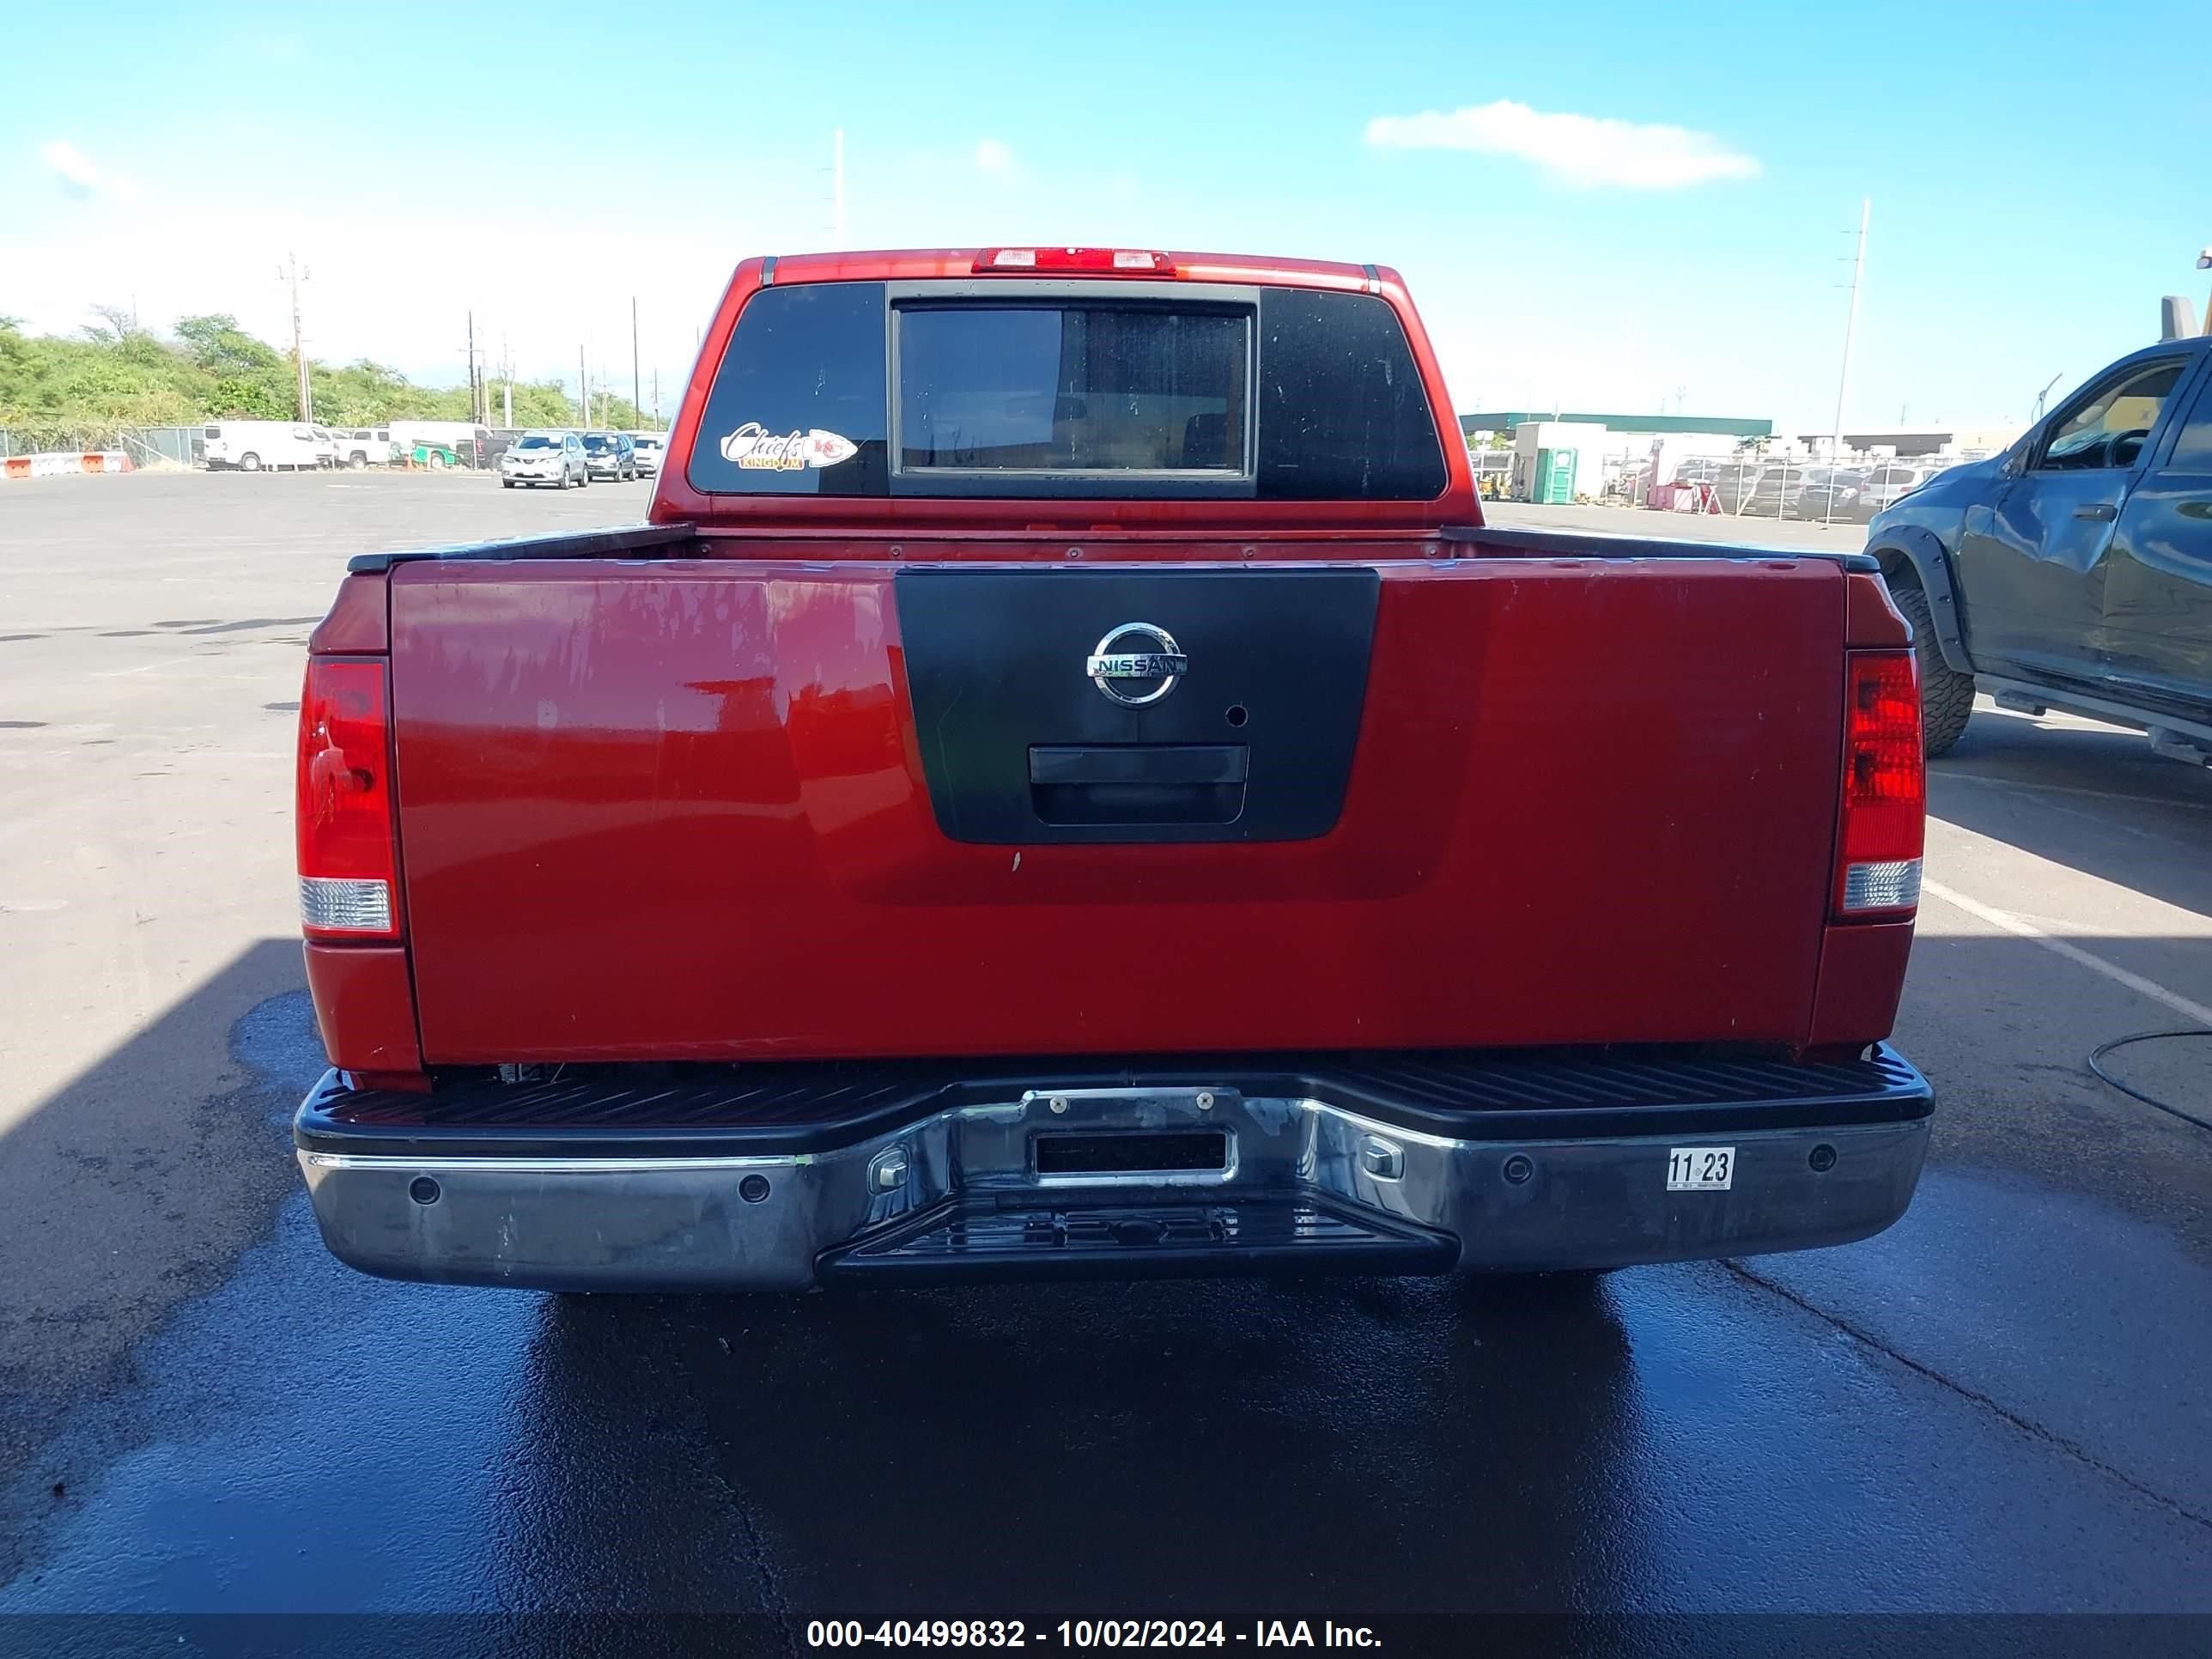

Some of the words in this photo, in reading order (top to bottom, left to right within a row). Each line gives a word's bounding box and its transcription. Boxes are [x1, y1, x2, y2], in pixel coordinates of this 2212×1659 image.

[726, 424, 800, 464] Chiefs
[1098, 659, 1176, 672] NISSAN
[1670, 1153, 1692, 1182] 11
[1702, 1153, 1729, 1182] 23
